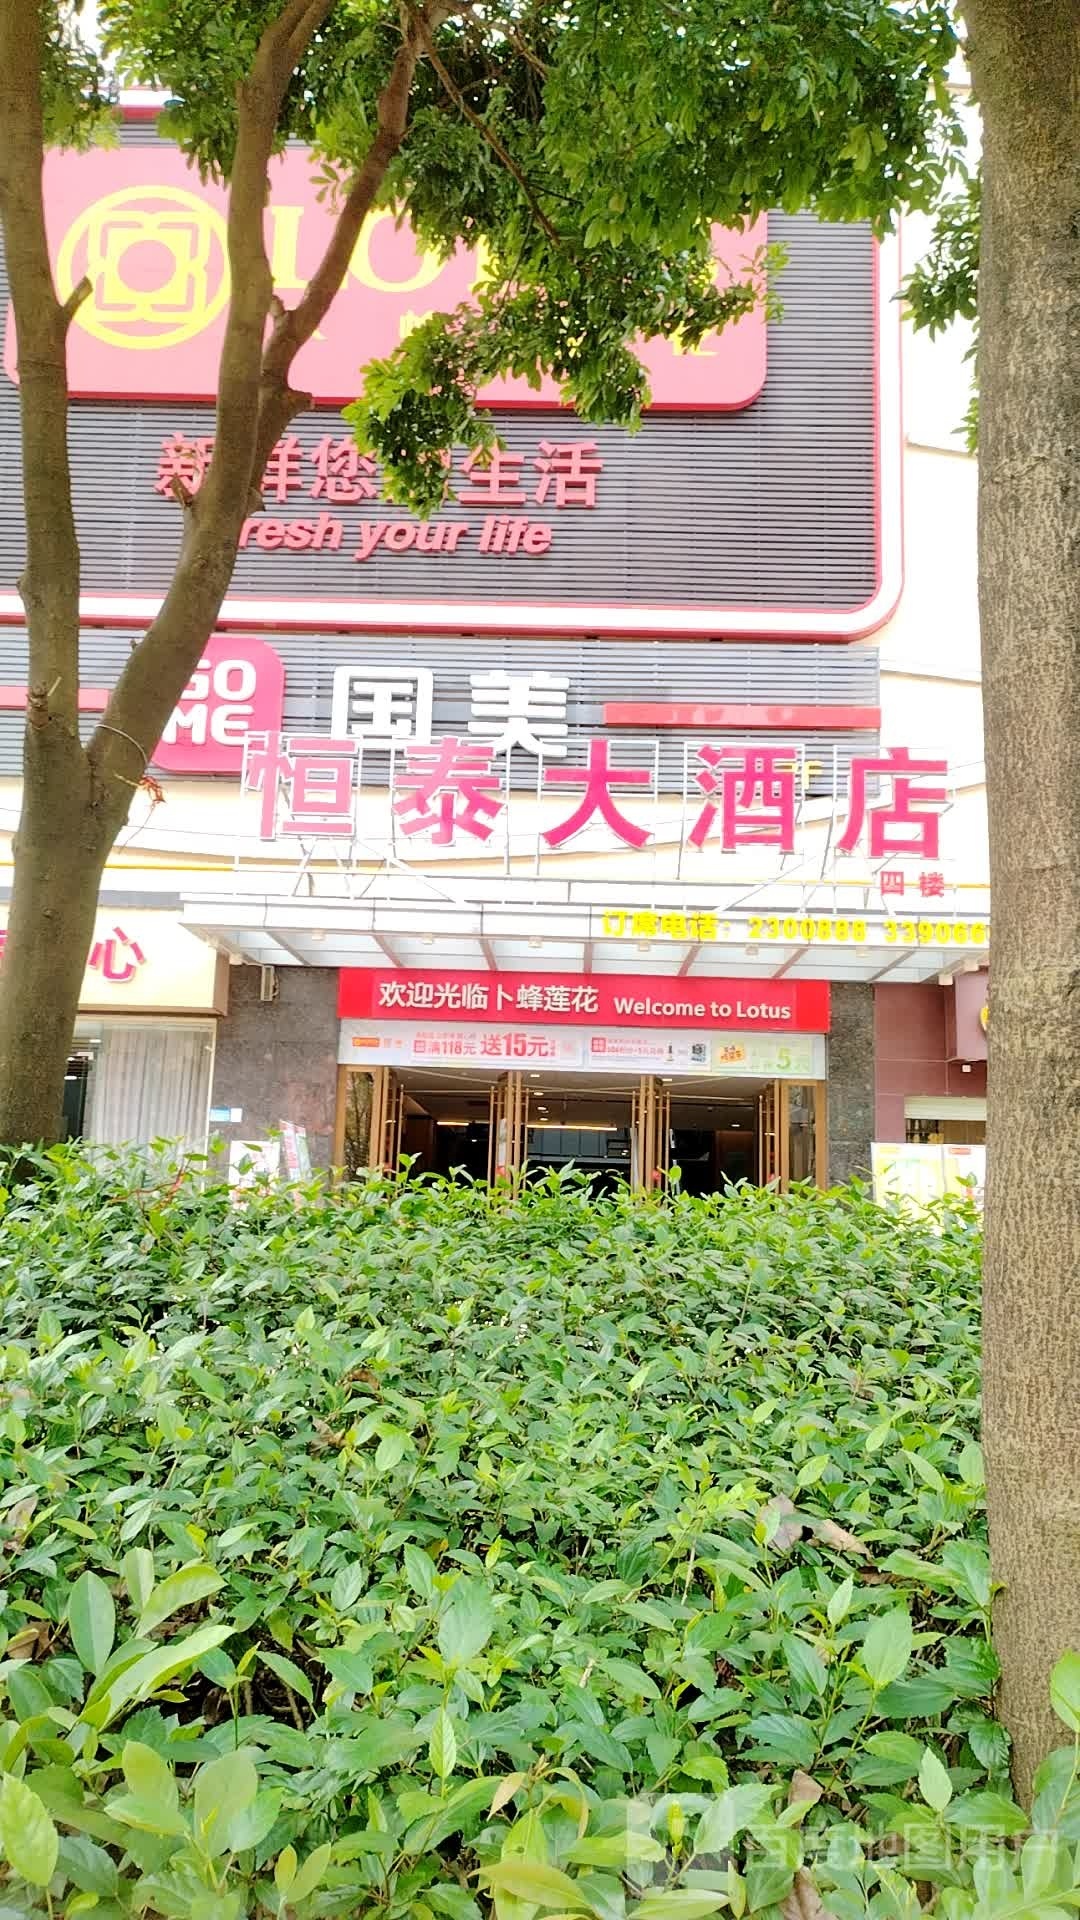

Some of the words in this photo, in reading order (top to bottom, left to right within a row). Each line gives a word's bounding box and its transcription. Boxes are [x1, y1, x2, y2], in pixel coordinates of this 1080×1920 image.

[238, 511, 344, 552] resh
[354, 517, 470, 562] your
[477, 514, 553, 555] life
[331, 665, 571, 757] 国美
[243, 731, 949, 860] 恒泰大酒店
[880, 871, 946, 898] 四楼
[747, 916, 868, 943] 2300888
[883, 918, 989, 945] 339066
[379, 981, 599, 1014] 欢迎光临卜蜂莲花
[613, 996, 706, 1017] Welcome
[711, 1002, 732, 1018] to
[736, 1002, 792, 1020] Lotus
